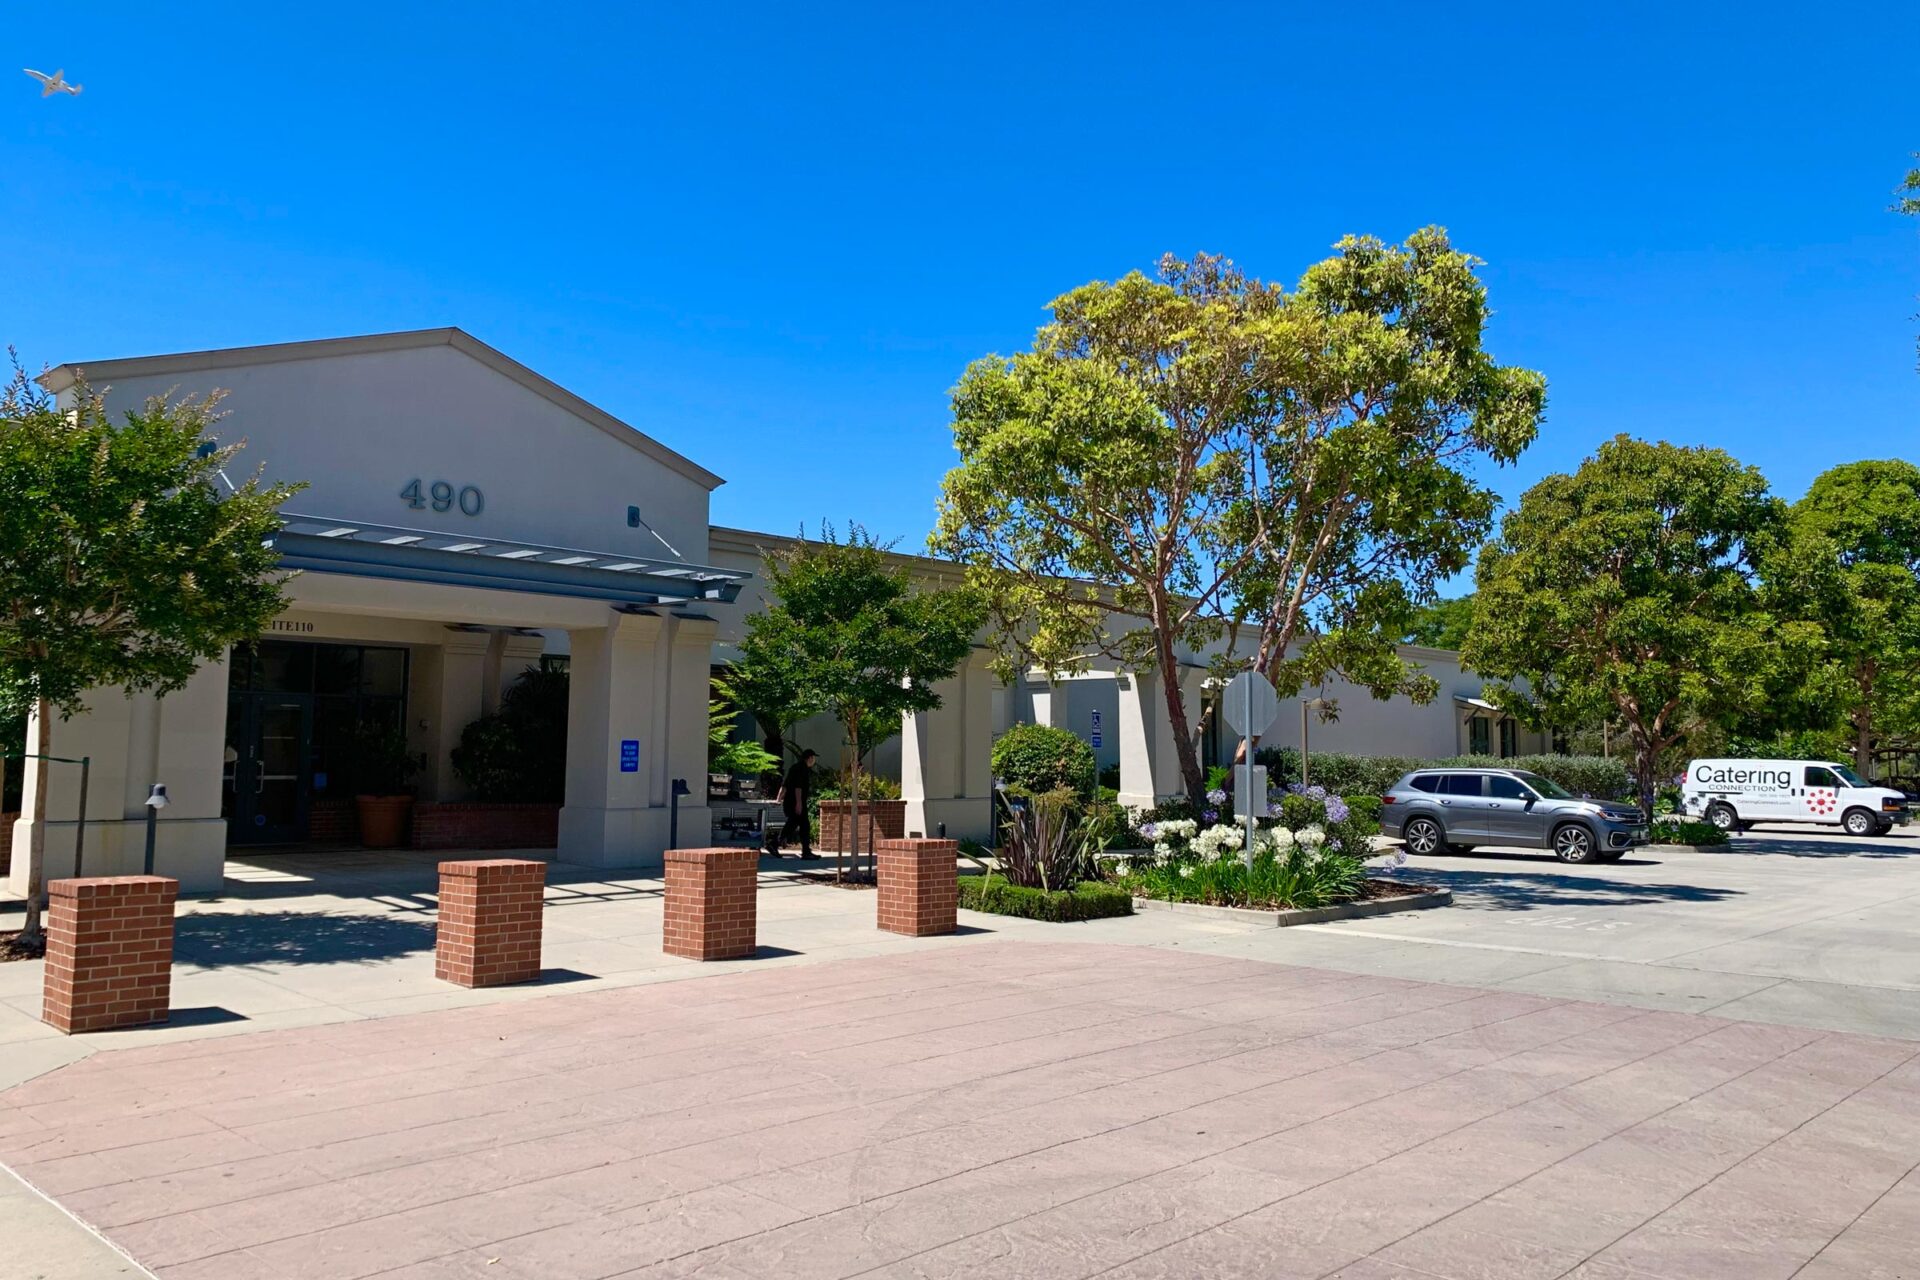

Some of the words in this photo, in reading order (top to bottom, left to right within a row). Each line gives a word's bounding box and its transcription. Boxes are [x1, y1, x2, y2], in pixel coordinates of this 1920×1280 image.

[400, 478, 485, 517] 490
[1696, 766, 1791, 790] Catering
[1708, 783, 1776, 793] CONNECTION
